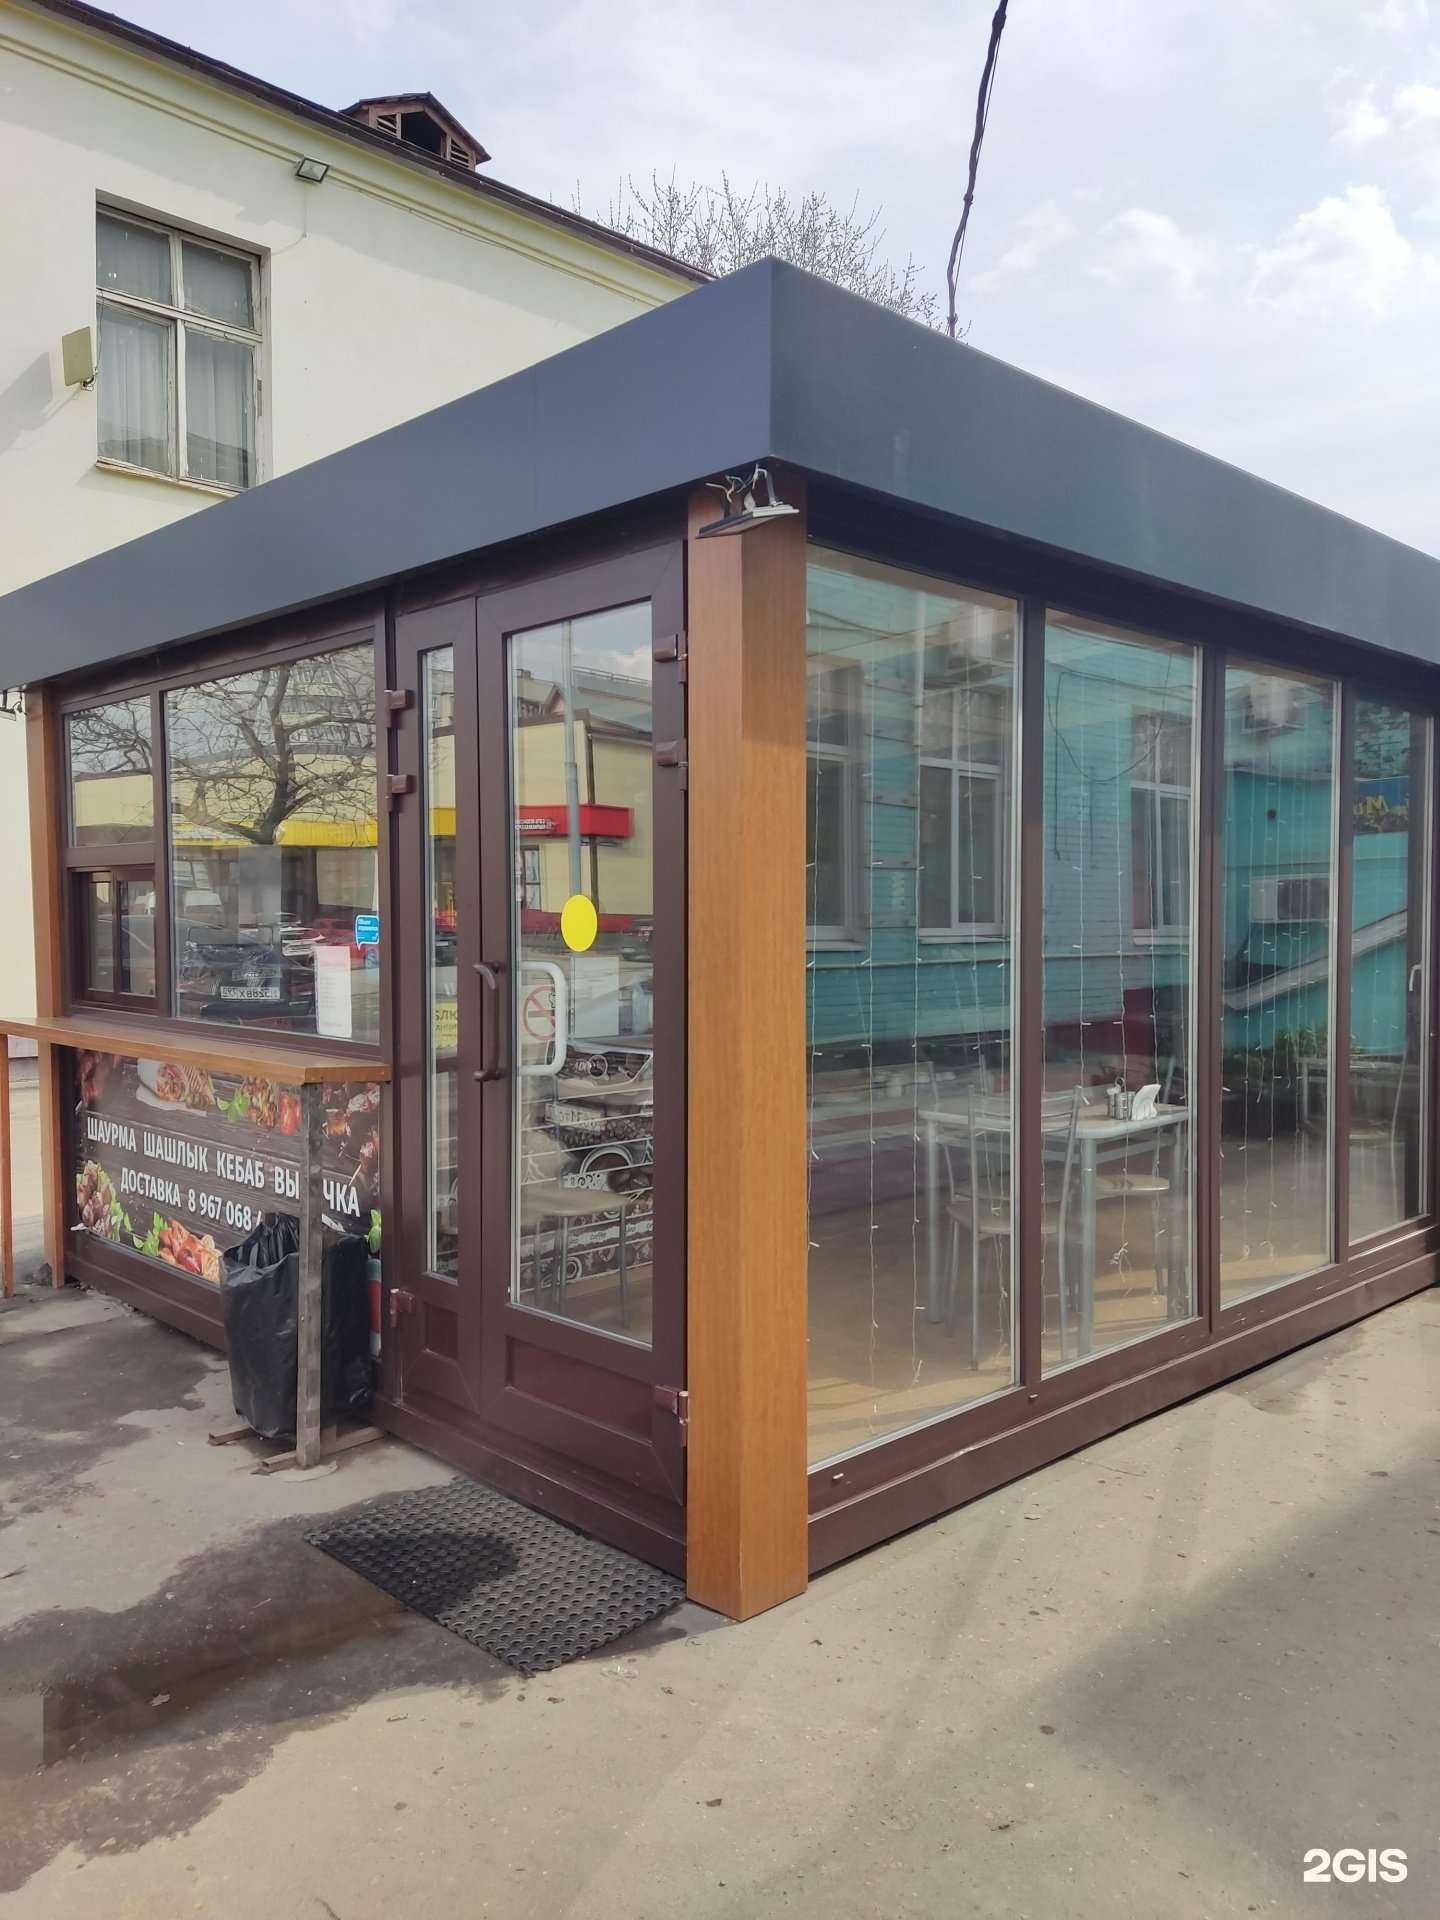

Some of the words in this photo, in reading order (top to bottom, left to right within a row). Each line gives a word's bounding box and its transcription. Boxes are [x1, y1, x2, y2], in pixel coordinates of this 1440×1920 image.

[87, 1116, 137, 1152] ШАУРМА
[143, 1131, 208, 1173] ШАШЛЫК
[216, 1150, 265, 1189] КЕБАБ
[274, 1165, 361, 1218] ВЫЧКА
[120, 1167, 181, 1207] ДОСТАВКА
[187, 1188, 196, 1212] 8
[200, 1192, 222, 1220] 967
[226, 1200, 252, 1231] 068
